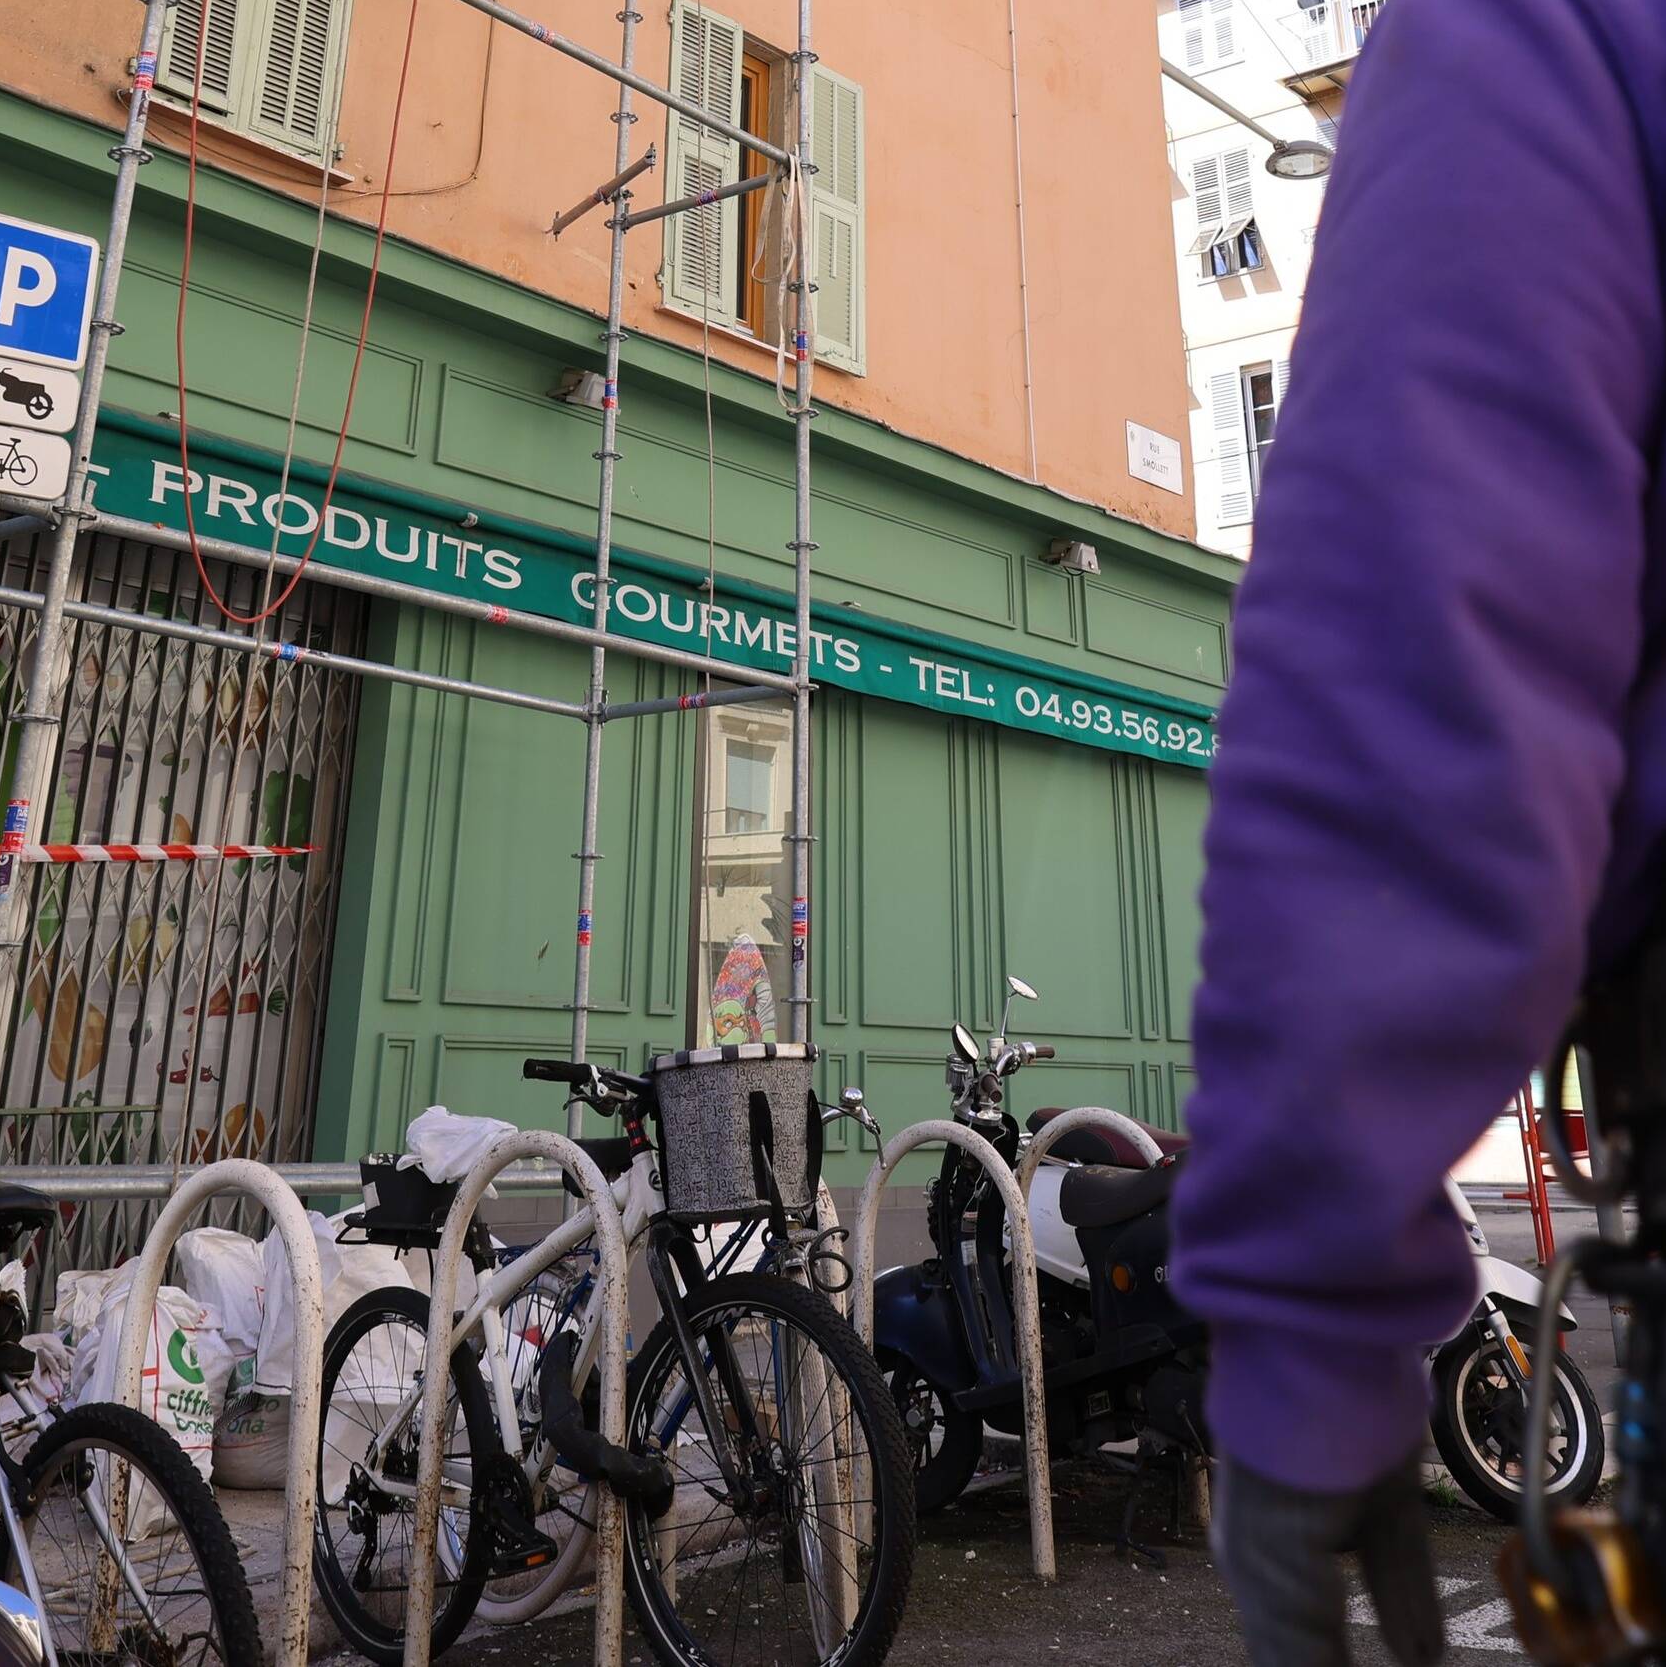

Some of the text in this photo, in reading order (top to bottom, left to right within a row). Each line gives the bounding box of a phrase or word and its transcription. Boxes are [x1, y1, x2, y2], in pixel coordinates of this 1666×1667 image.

[1149, 441, 1160, 455] RUE
[1142, 457, 1169, 476] SMOLLETT
[148, 458, 523, 590] PRODUITS
[571, 571, 861, 674] GOURMETS
[909, 656, 996, 707] TEL:
